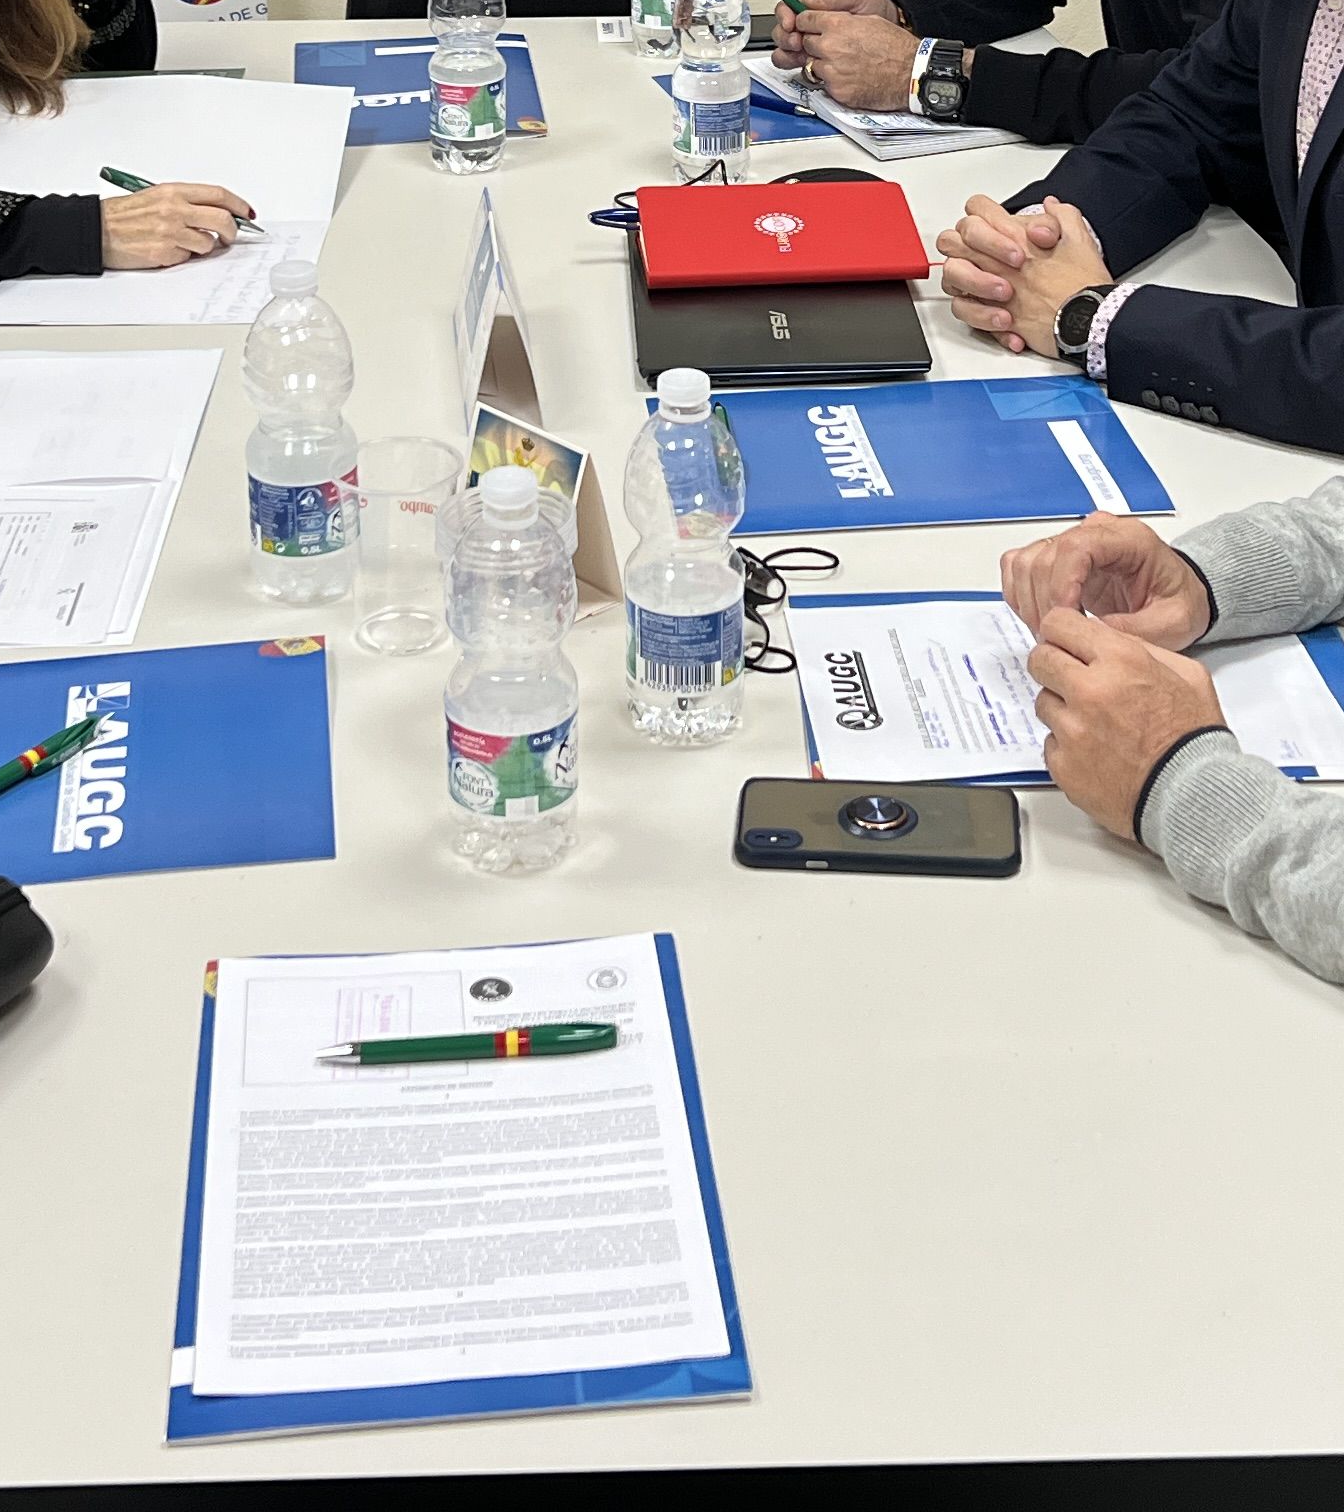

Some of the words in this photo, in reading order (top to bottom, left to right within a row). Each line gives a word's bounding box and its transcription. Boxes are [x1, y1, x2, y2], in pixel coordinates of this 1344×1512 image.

[807, 404, 870, 481] AUGC
[823, 651, 866, 708] AUGC
[74, 718, 131, 850] AUGC
